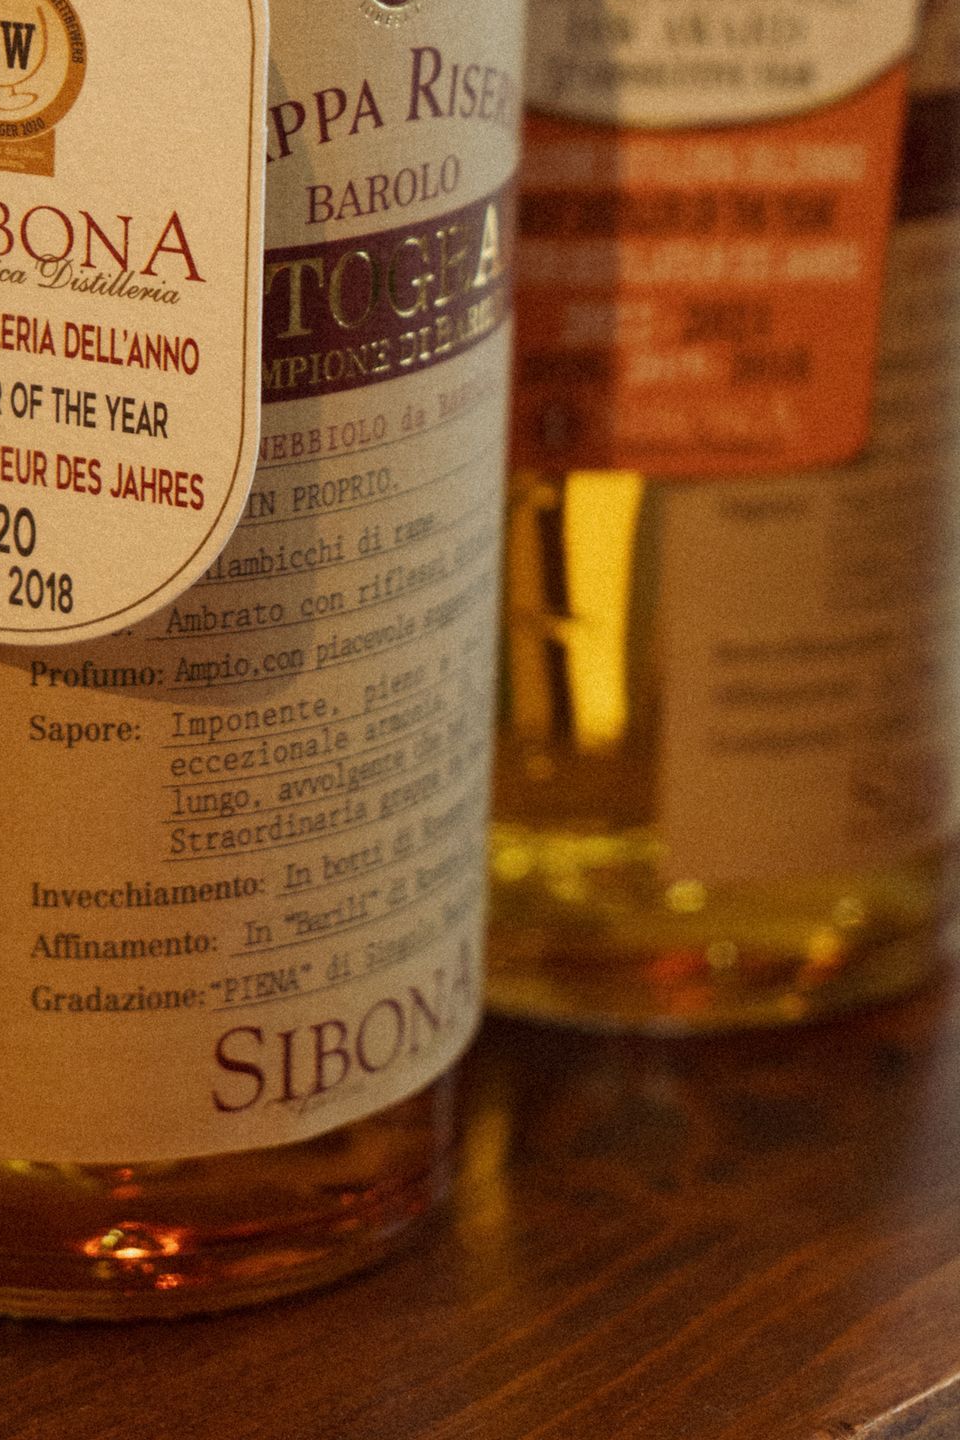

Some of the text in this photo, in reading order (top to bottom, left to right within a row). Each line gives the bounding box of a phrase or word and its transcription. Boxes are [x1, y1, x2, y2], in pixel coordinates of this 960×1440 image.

[264, 78, 385, 164] PPA
[305, 154, 461, 225] BAROLO
[33, 252, 181, 306] Distilleria
[63, 321, 200, 376] DELL'ANNO
[10, 382, 42, 420] OF
[51, 388, 97, 428] THE
[104, 396, 169, 438] YEAR
[55, 453, 102, 496] DES
[109, 463, 205, 511] JAHRES
[8, 565, 74, 614] 2018
[165, 599, 285, 634] Ambrato
[29, 659, 164, 688] Profumo:
[29, 714, 141, 749] Sapore:
[170, 727, 350, 777] eccezionale
[170, 799, 369, 855] Straordinaria
[30, 874, 266, 909] Invecchiamento:
[29, 930, 219, 961] Affinamento:
[29, 983, 207, 1014] Gradazione:
